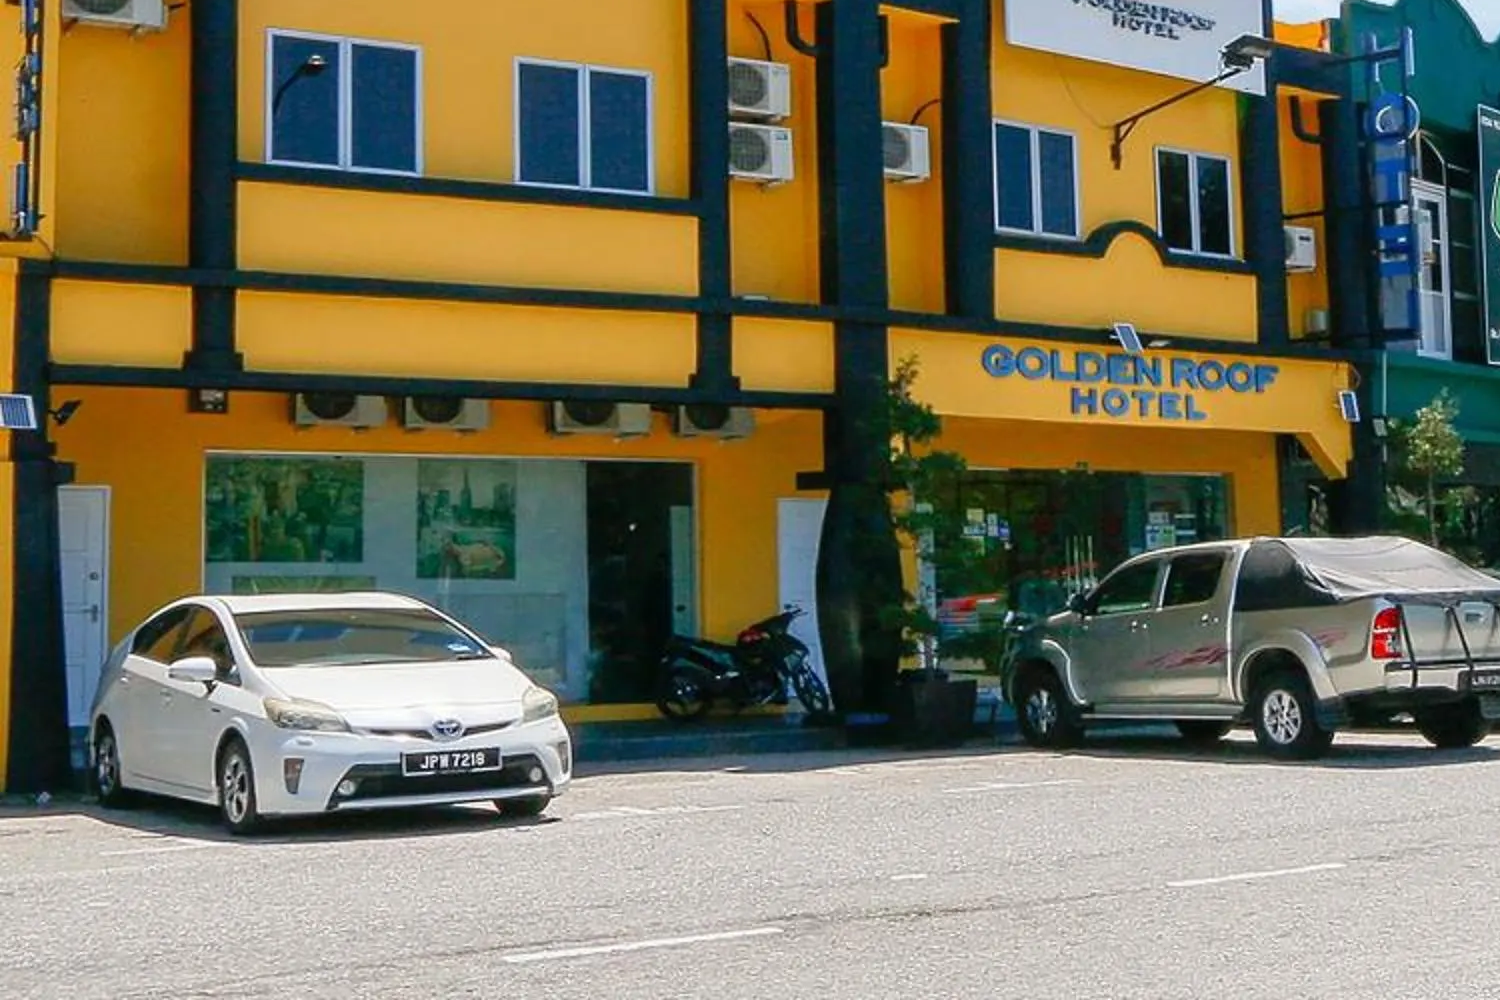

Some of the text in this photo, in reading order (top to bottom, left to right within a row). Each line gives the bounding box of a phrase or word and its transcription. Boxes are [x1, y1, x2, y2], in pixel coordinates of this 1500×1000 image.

[1112, 12, 1180, 40] HOTEL
[981, 343, 1280, 394] GOLDEN ROOF
[1071, 387, 1208, 421] HOTEL
